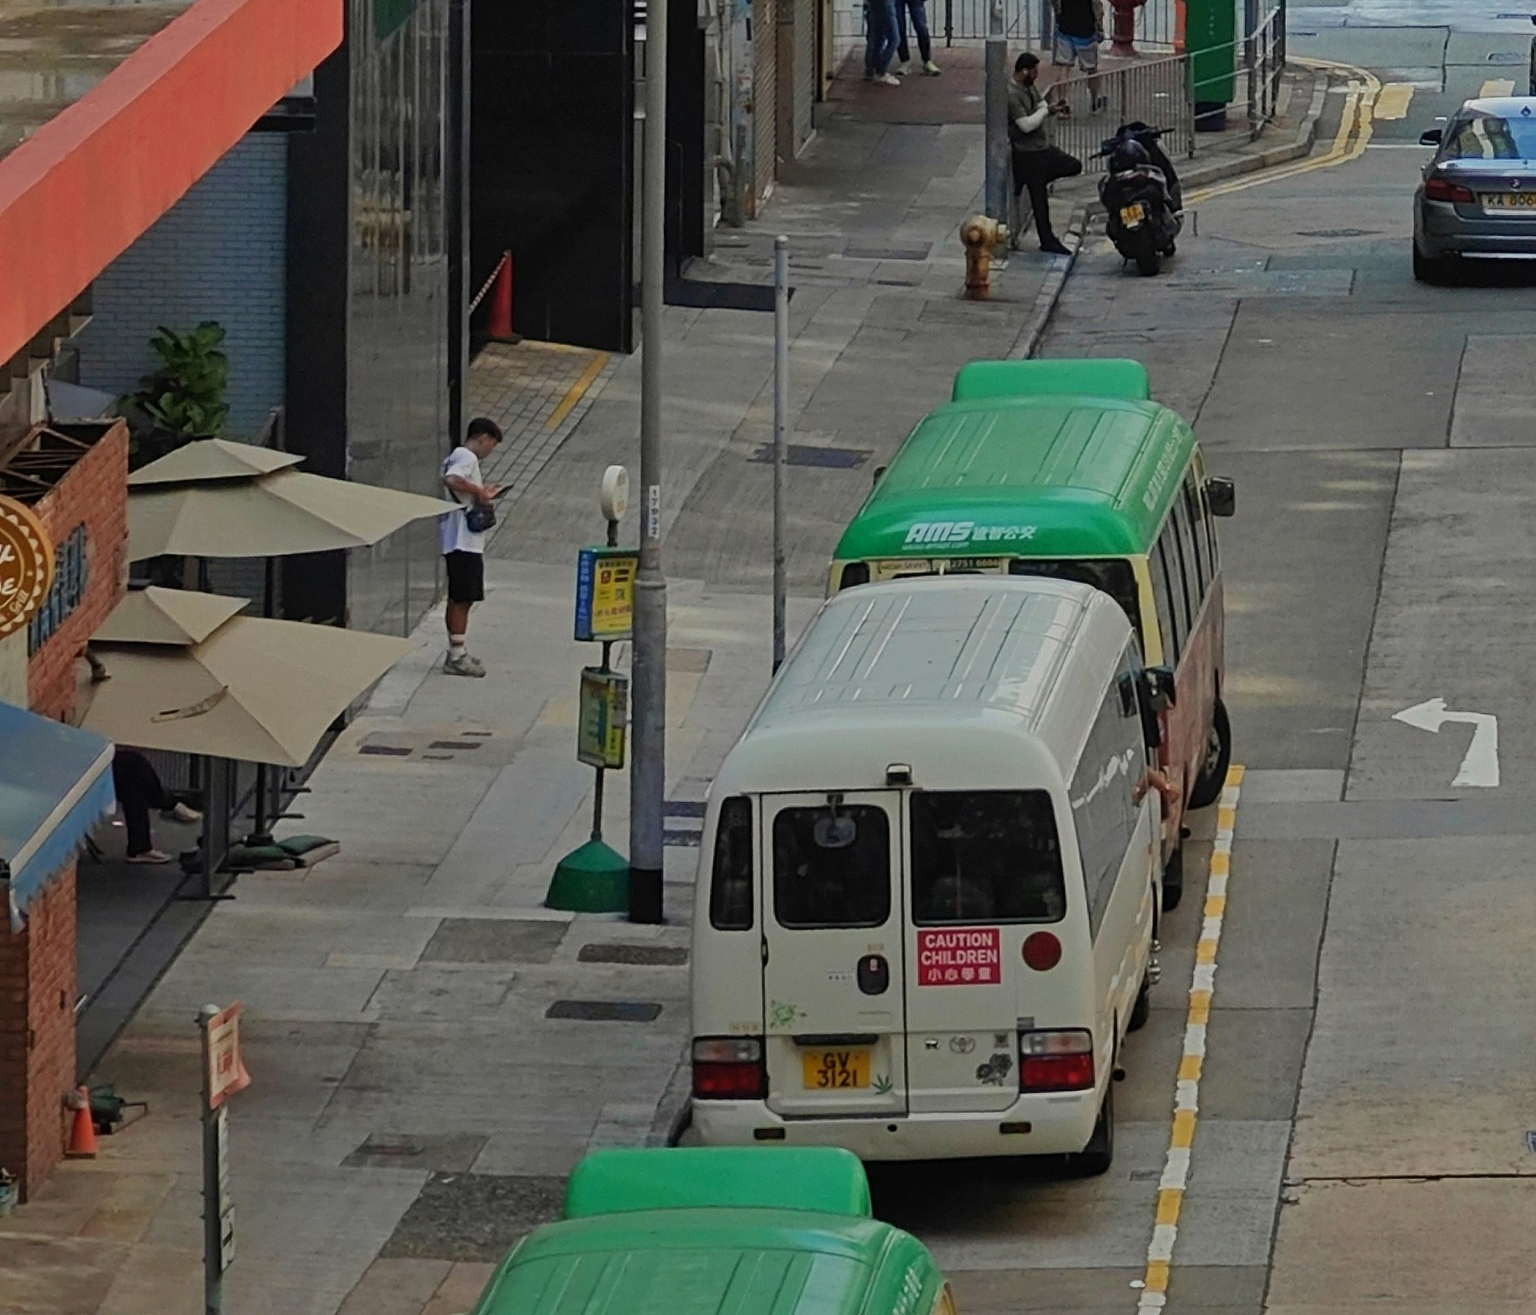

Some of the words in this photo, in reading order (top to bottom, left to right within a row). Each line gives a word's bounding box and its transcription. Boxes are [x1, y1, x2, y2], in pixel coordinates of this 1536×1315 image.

[905, 522, 974, 542] AMS
[925, 933, 993, 948] CAUTION
[920, 950, 998, 966] CHILDREN
[822, 1052, 850, 1069] GV
[816, 1070, 858, 1088] 3121
